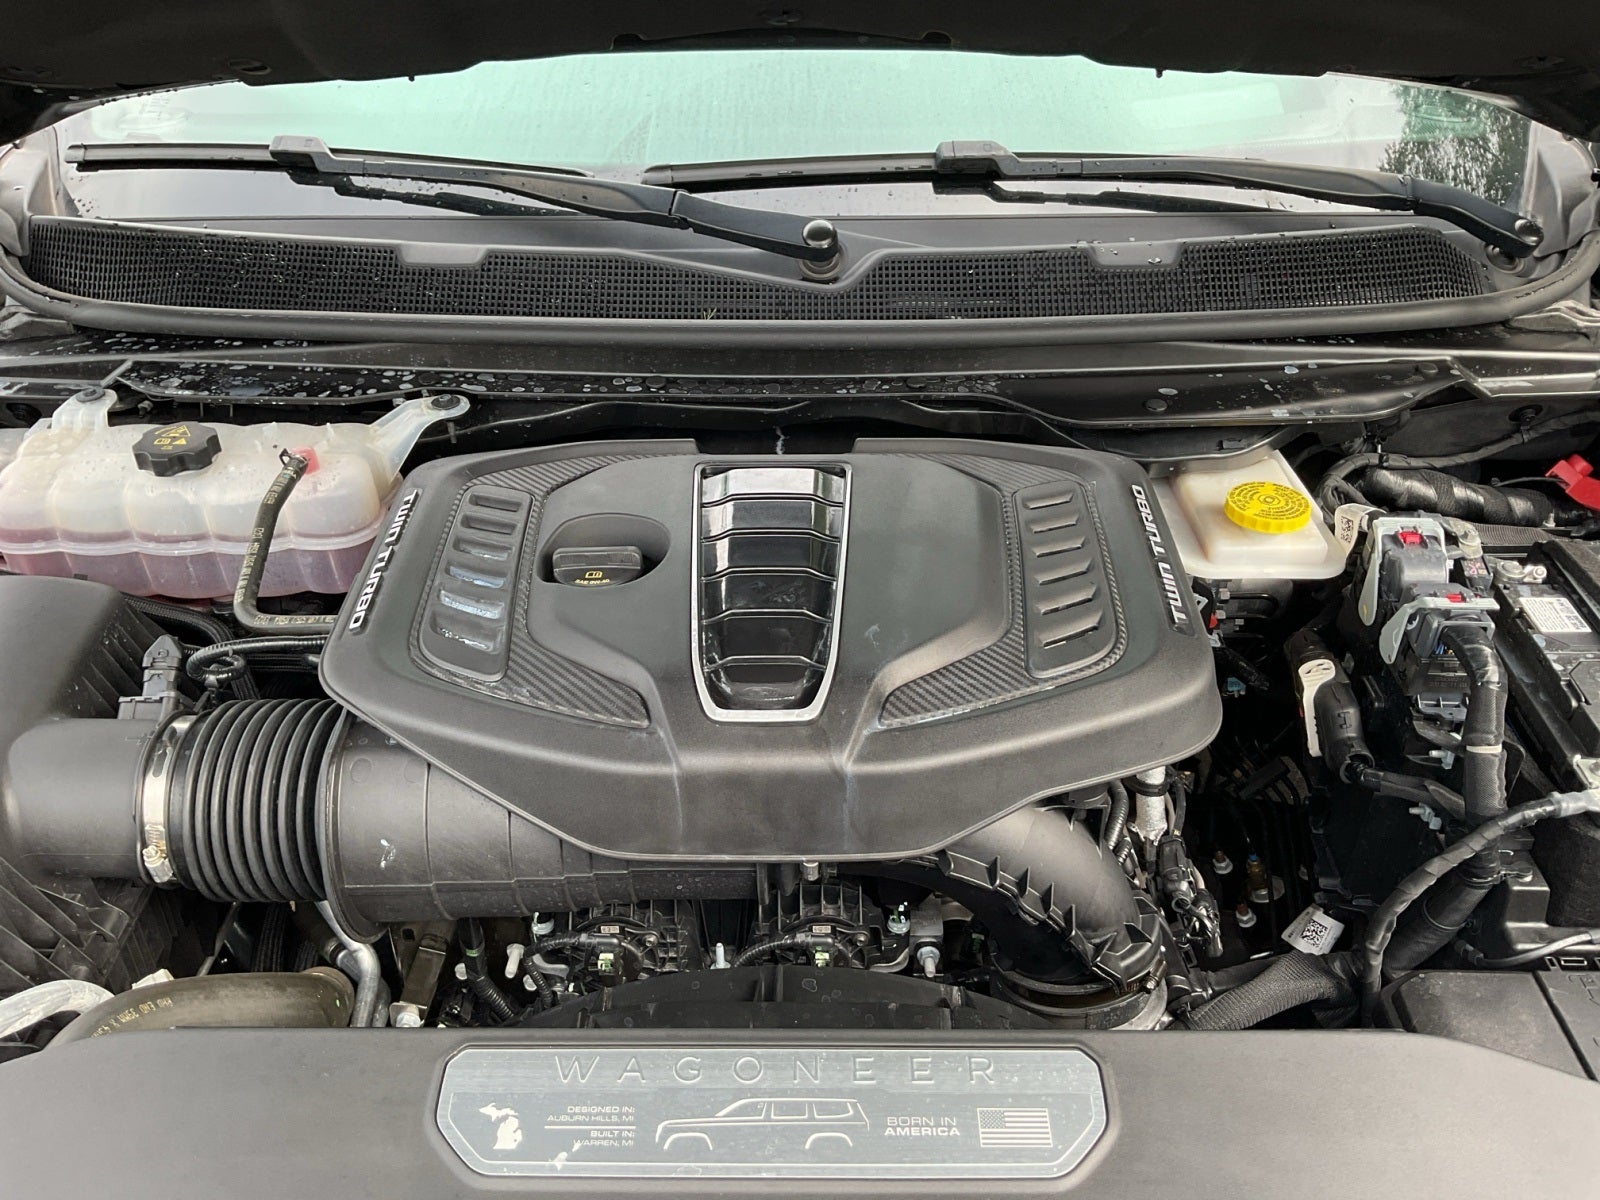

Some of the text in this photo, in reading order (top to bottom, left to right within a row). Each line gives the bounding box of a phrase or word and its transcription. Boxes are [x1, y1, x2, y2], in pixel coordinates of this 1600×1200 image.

[1131, 484, 1188, 623] TWIN TURBO
[349, 489, 418, 633] TWIN TURBO
[555, 1055, 995, 1083] WAGONEER
[591, 1114, 620, 1122] HILLS,
[887, 1116, 957, 1126] BORN IN
[590, 1130, 636, 1138] BUILT IN:
[884, 1127, 961, 1136] AMERICA
[573, 1139, 620, 1147] WARREN,
